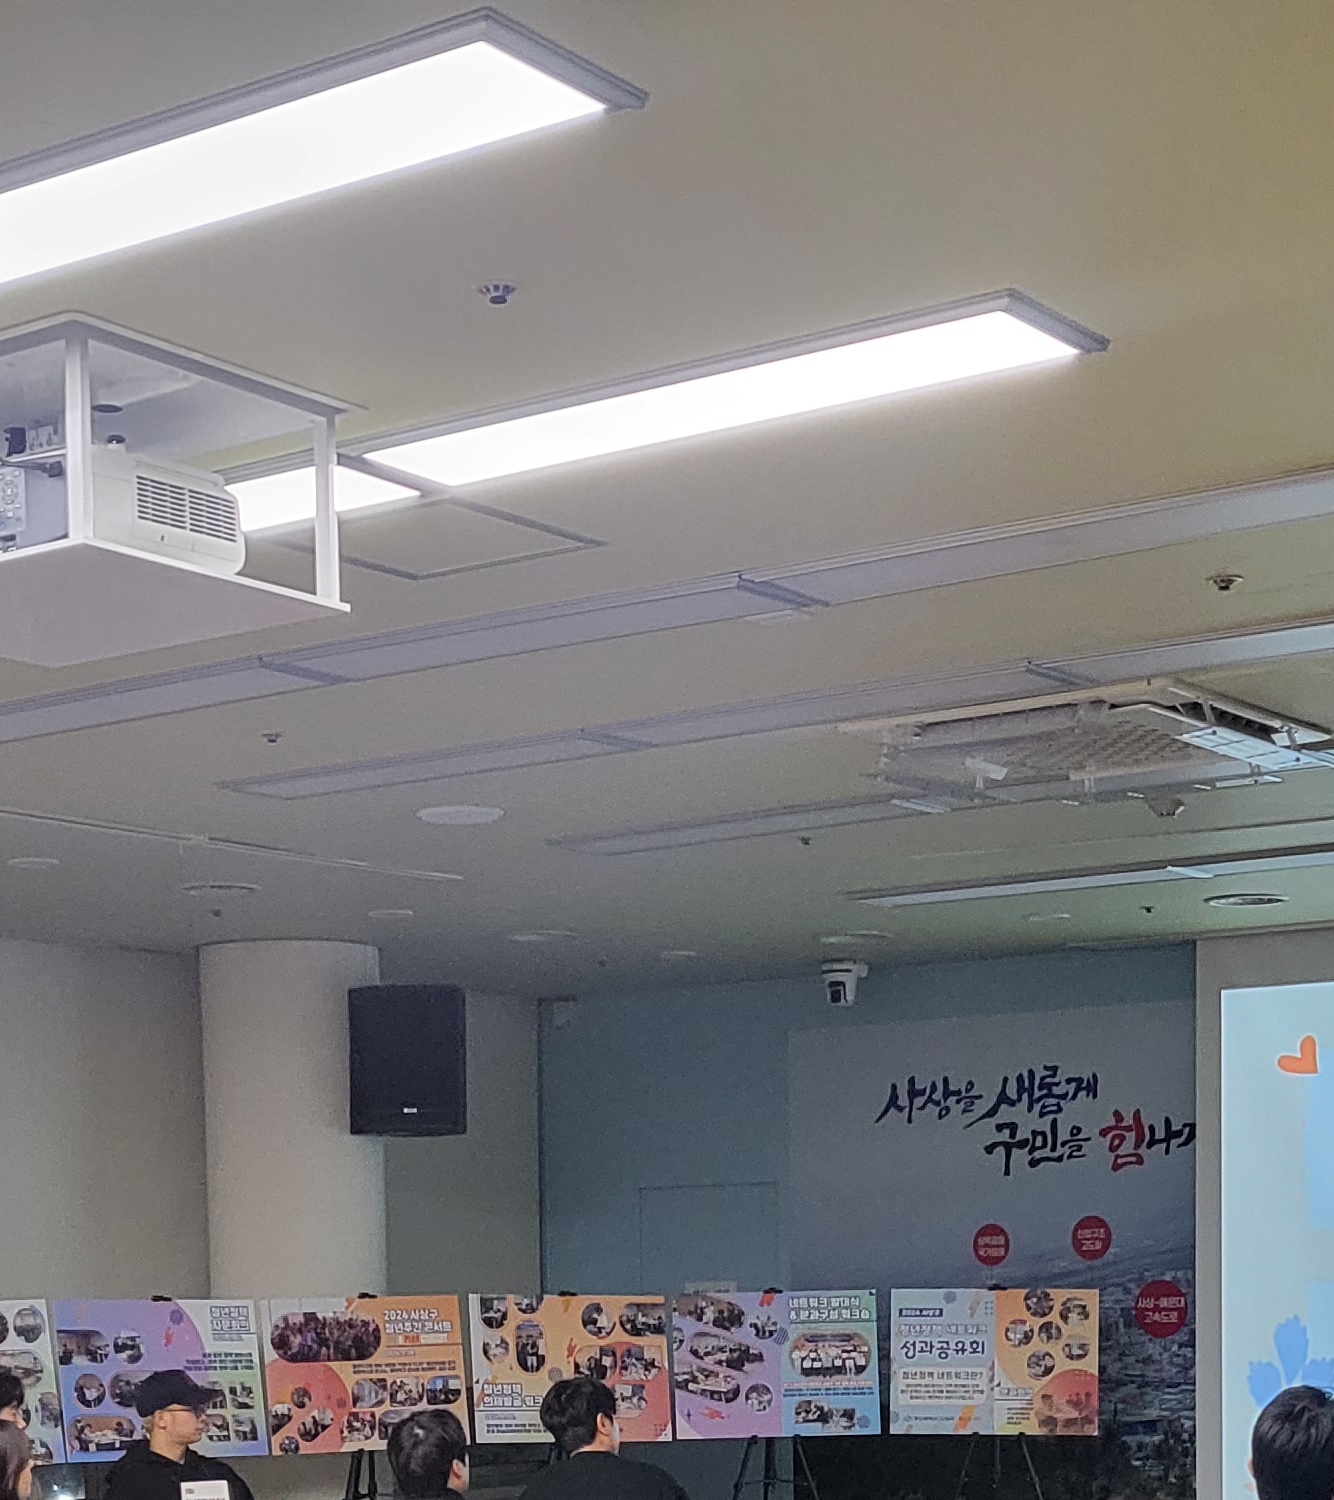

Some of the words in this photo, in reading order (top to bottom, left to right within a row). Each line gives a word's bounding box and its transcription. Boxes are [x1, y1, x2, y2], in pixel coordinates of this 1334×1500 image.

[874, 1076, 984, 1124] 사상을
[963, 1065, 1098, 1128] 새롭게
[984, 1119, 1091, 1176] 구민을
[384, 1310, 408, 1320] 2024
[410, 1309, 438, 1319] 사상구
[1144, 1312, 1178, 1323] 고속도로
[899, 1324, 943, 1337] 청년정책
[946, 1324, 987, 1335] 네트워크
[900, 1340, 985, 1360] 성과공유회
